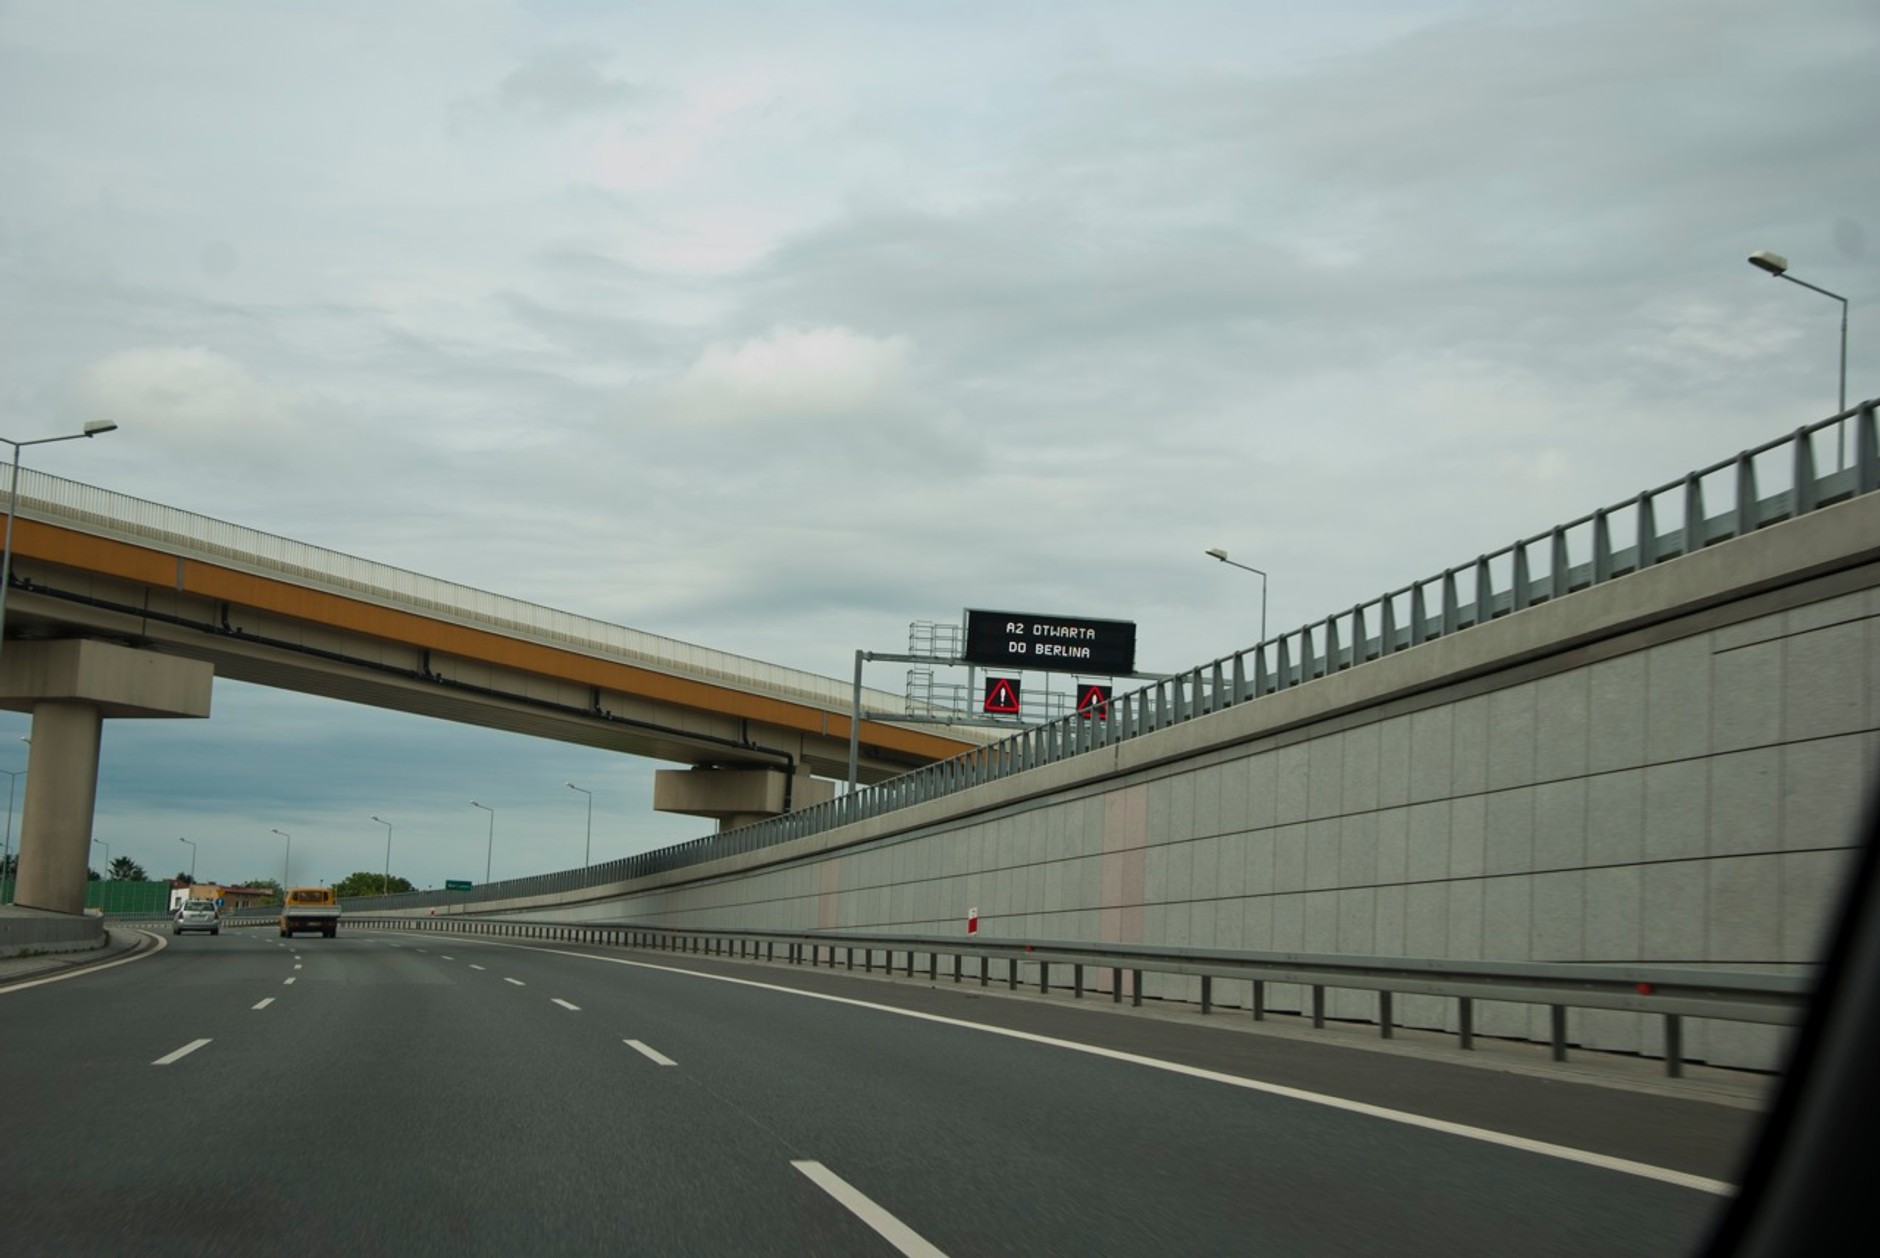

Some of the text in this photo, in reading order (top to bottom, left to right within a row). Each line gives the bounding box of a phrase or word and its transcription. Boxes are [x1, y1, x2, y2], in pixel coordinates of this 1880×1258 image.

[1006, 622, 1095, 639] A2 OTWARTA
[1008, 641, 1090, 658] DO BERLINA
